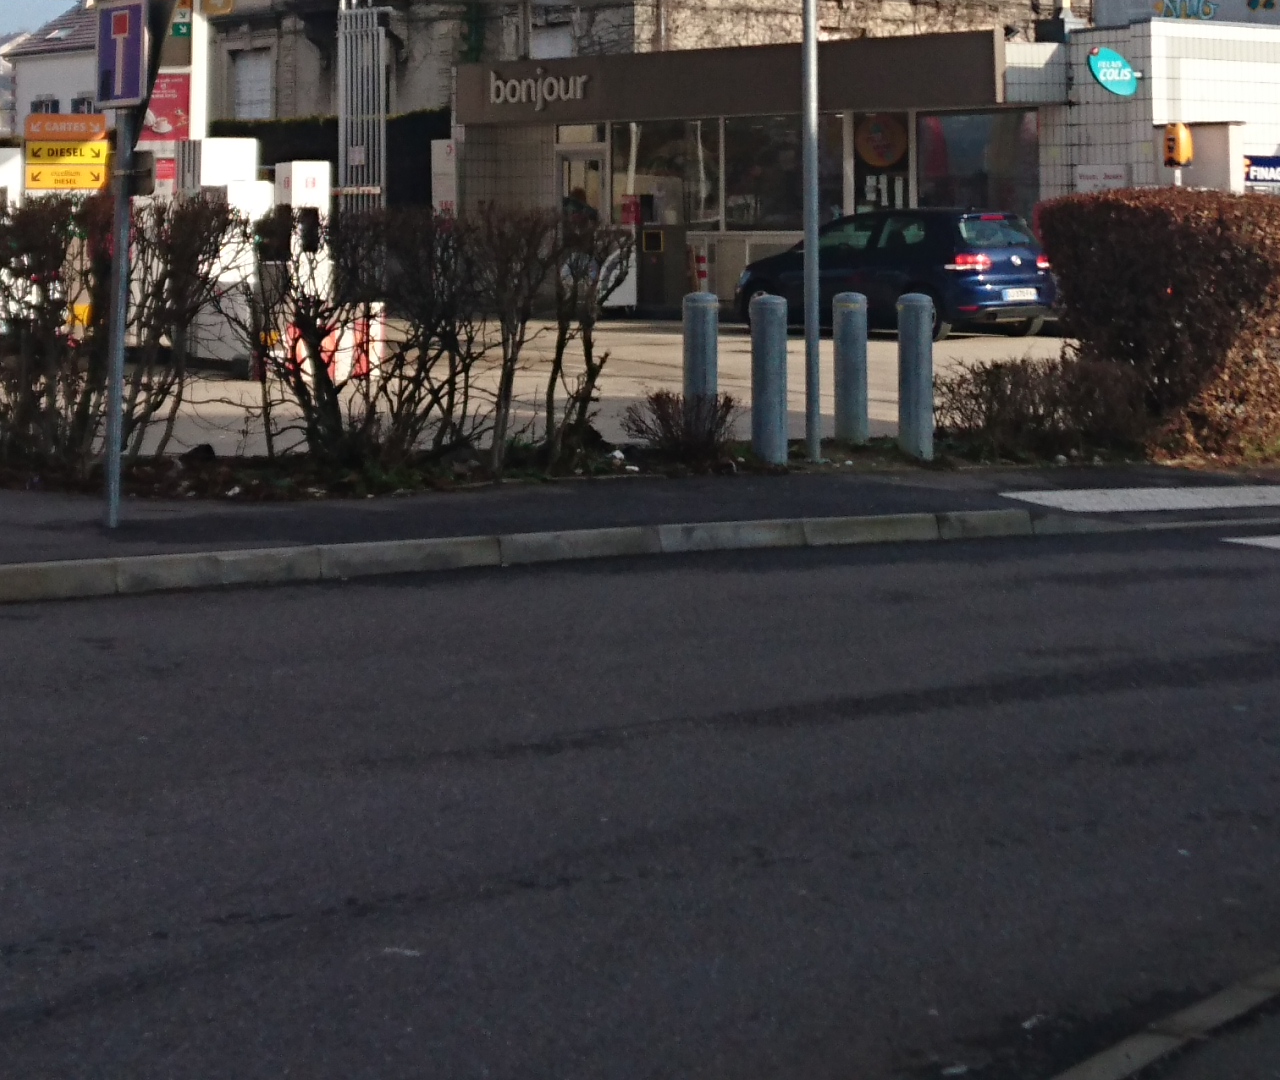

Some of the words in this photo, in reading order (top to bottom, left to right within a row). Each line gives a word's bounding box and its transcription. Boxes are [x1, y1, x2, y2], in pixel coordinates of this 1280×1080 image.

[1099, 68, 1133, 81] COLIS
[490, 67, 589, 111] bonjour
[47, 147, 85, 158] DIESEL
